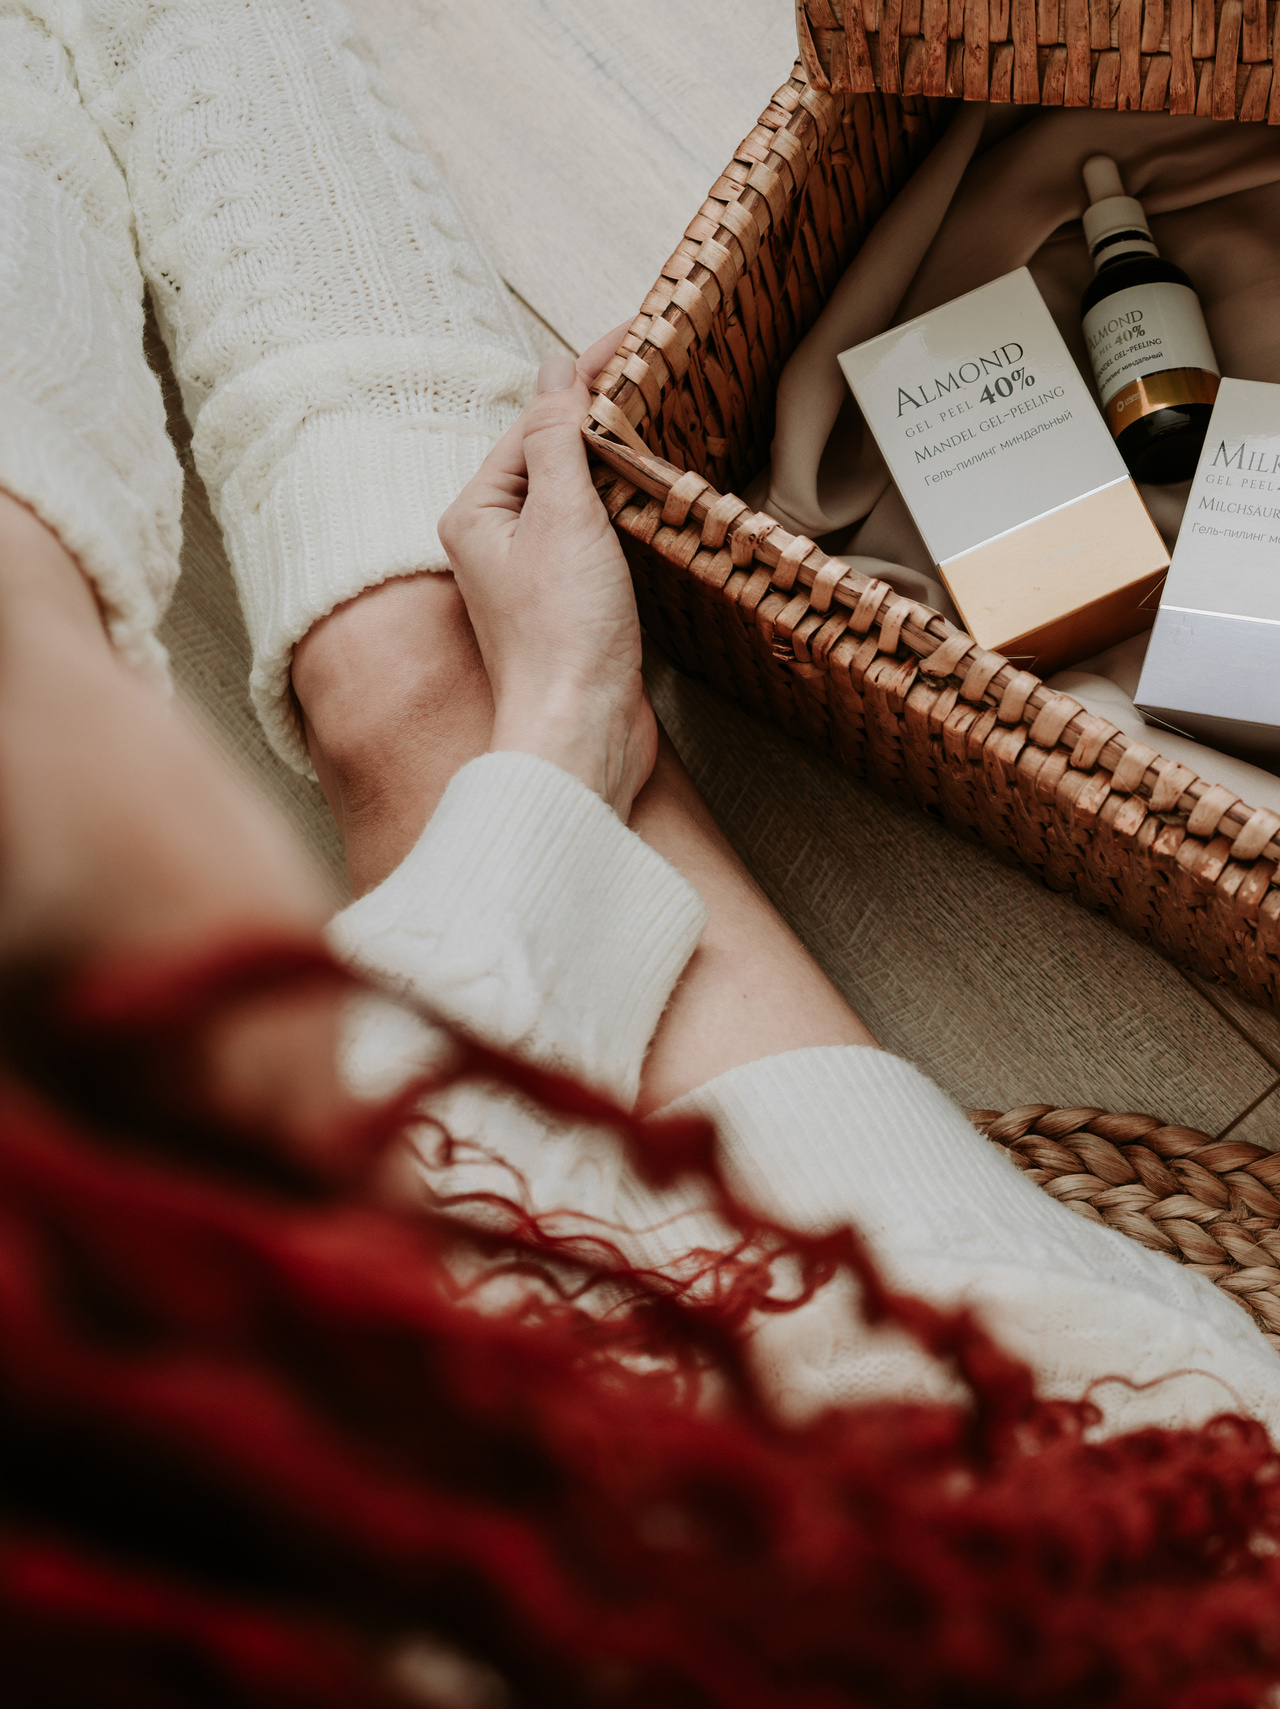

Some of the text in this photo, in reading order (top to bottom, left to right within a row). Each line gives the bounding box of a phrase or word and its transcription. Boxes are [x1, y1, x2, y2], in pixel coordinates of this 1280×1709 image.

[1088, 310, 1143, 350] ALMOND
[1114, 324, 1146, 346] 40%
[1114, 338, 1162, 361] GEL-PEELING
[896, 342, 1024, 418] ALMOND
[905, 367, 1036, 438] GEL PEEL 40%
[914, 386, 1066, 464] MANDEL GEL-PEELING
[924, 410, 1073, 486] Гель-пилинг миндальный
[1205, 474, 1232, 486] GEL
[1241, 478, 1274, 491] PEEL
[1192, 523, 1267, 542] Гель-пилинг
